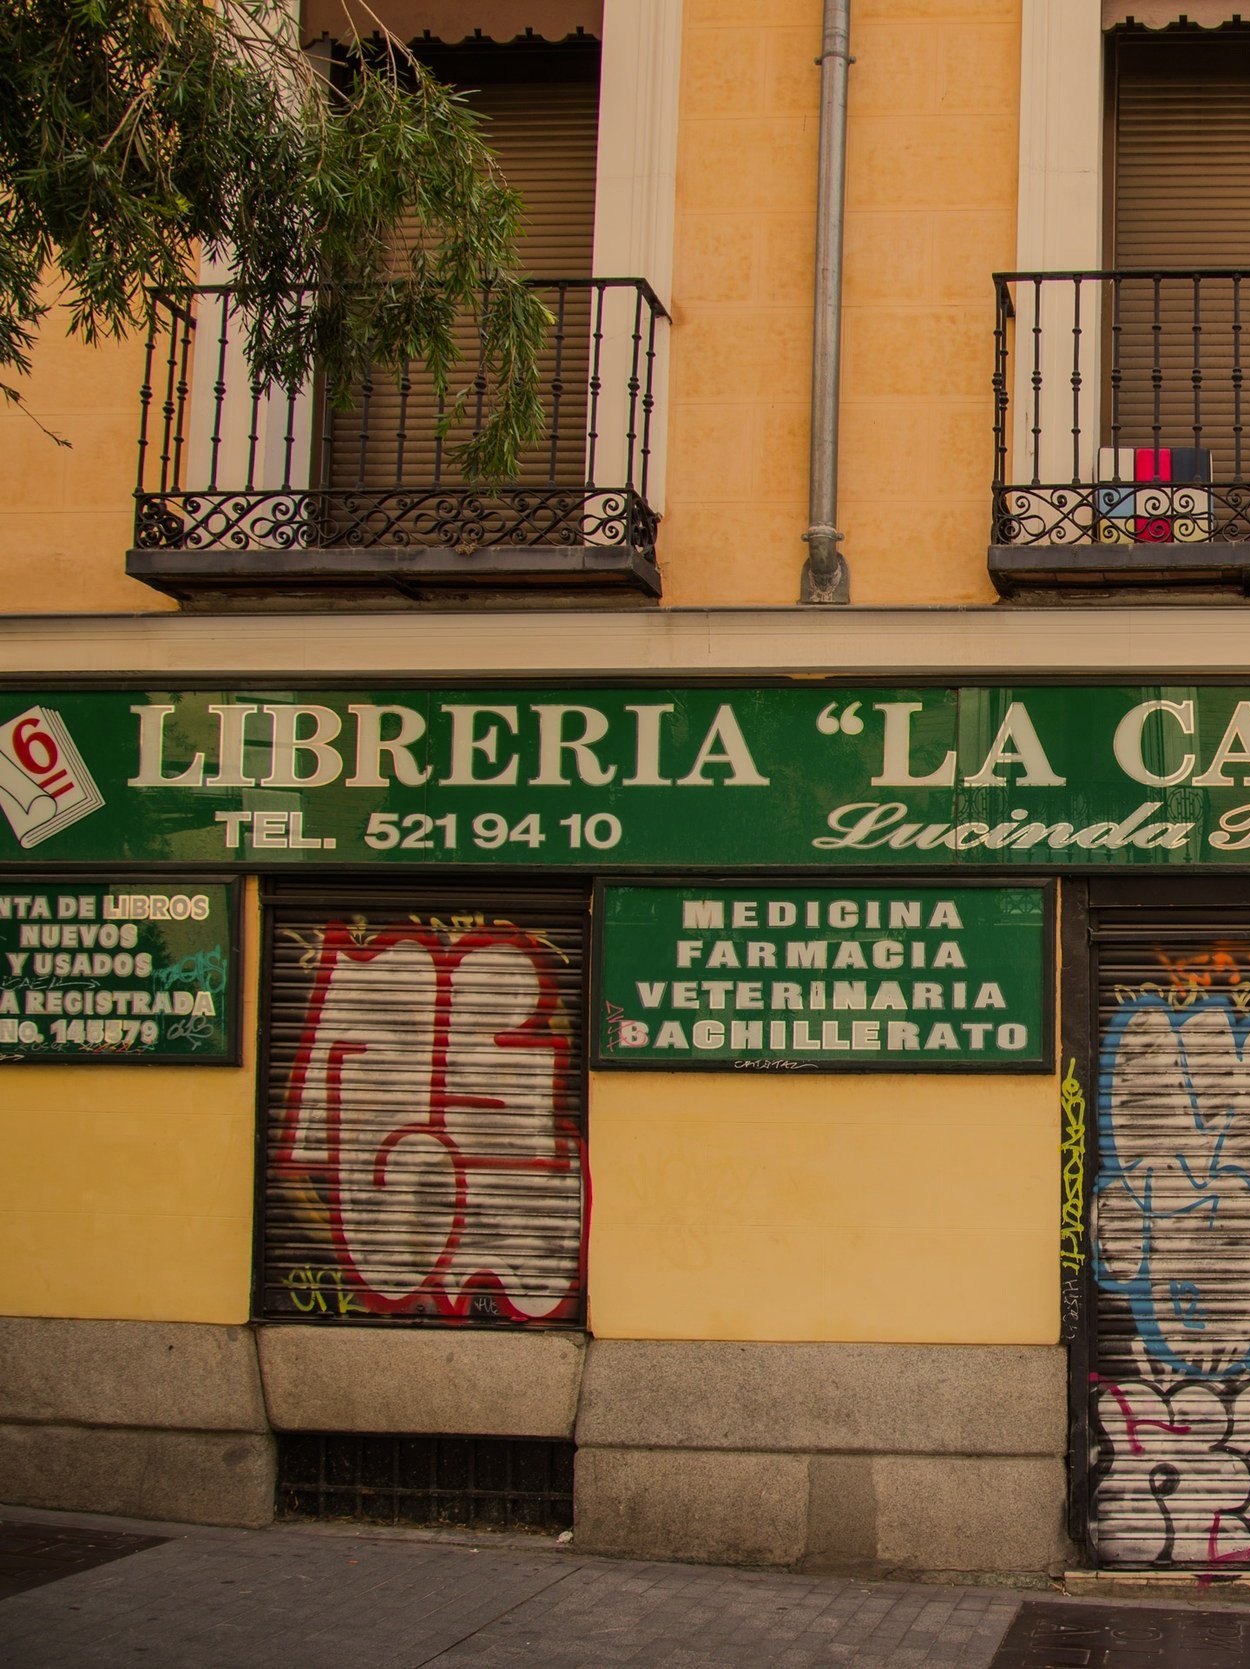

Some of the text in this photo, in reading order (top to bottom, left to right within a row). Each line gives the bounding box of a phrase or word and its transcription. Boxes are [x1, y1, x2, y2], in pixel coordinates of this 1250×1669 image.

[12, 718, 58, 775] 6
[128, 703, 769, 787] LIBRERIA
[215, 811, 620, 849] TEL. 521 94 10
[812, 802, 1195, 850] Lucinda
[59, 896, 93, 918] DE
[103, 895, 208, 920] LIBROS
[683, 901, 961, 928] MEDICINA
[20, 924, 138, 948] NUEVOS
[8, 954, 24, 975] Y
[34, 953, 149, 977] USADOS
[677, 940, 965, 969] FARMACIA
[26, 991, 213, 1017] REGISTRADA
[637, 982, 1005, 1010] VETERINARIA
[618, 1020, 1026, 1050] BACHILLERATO
